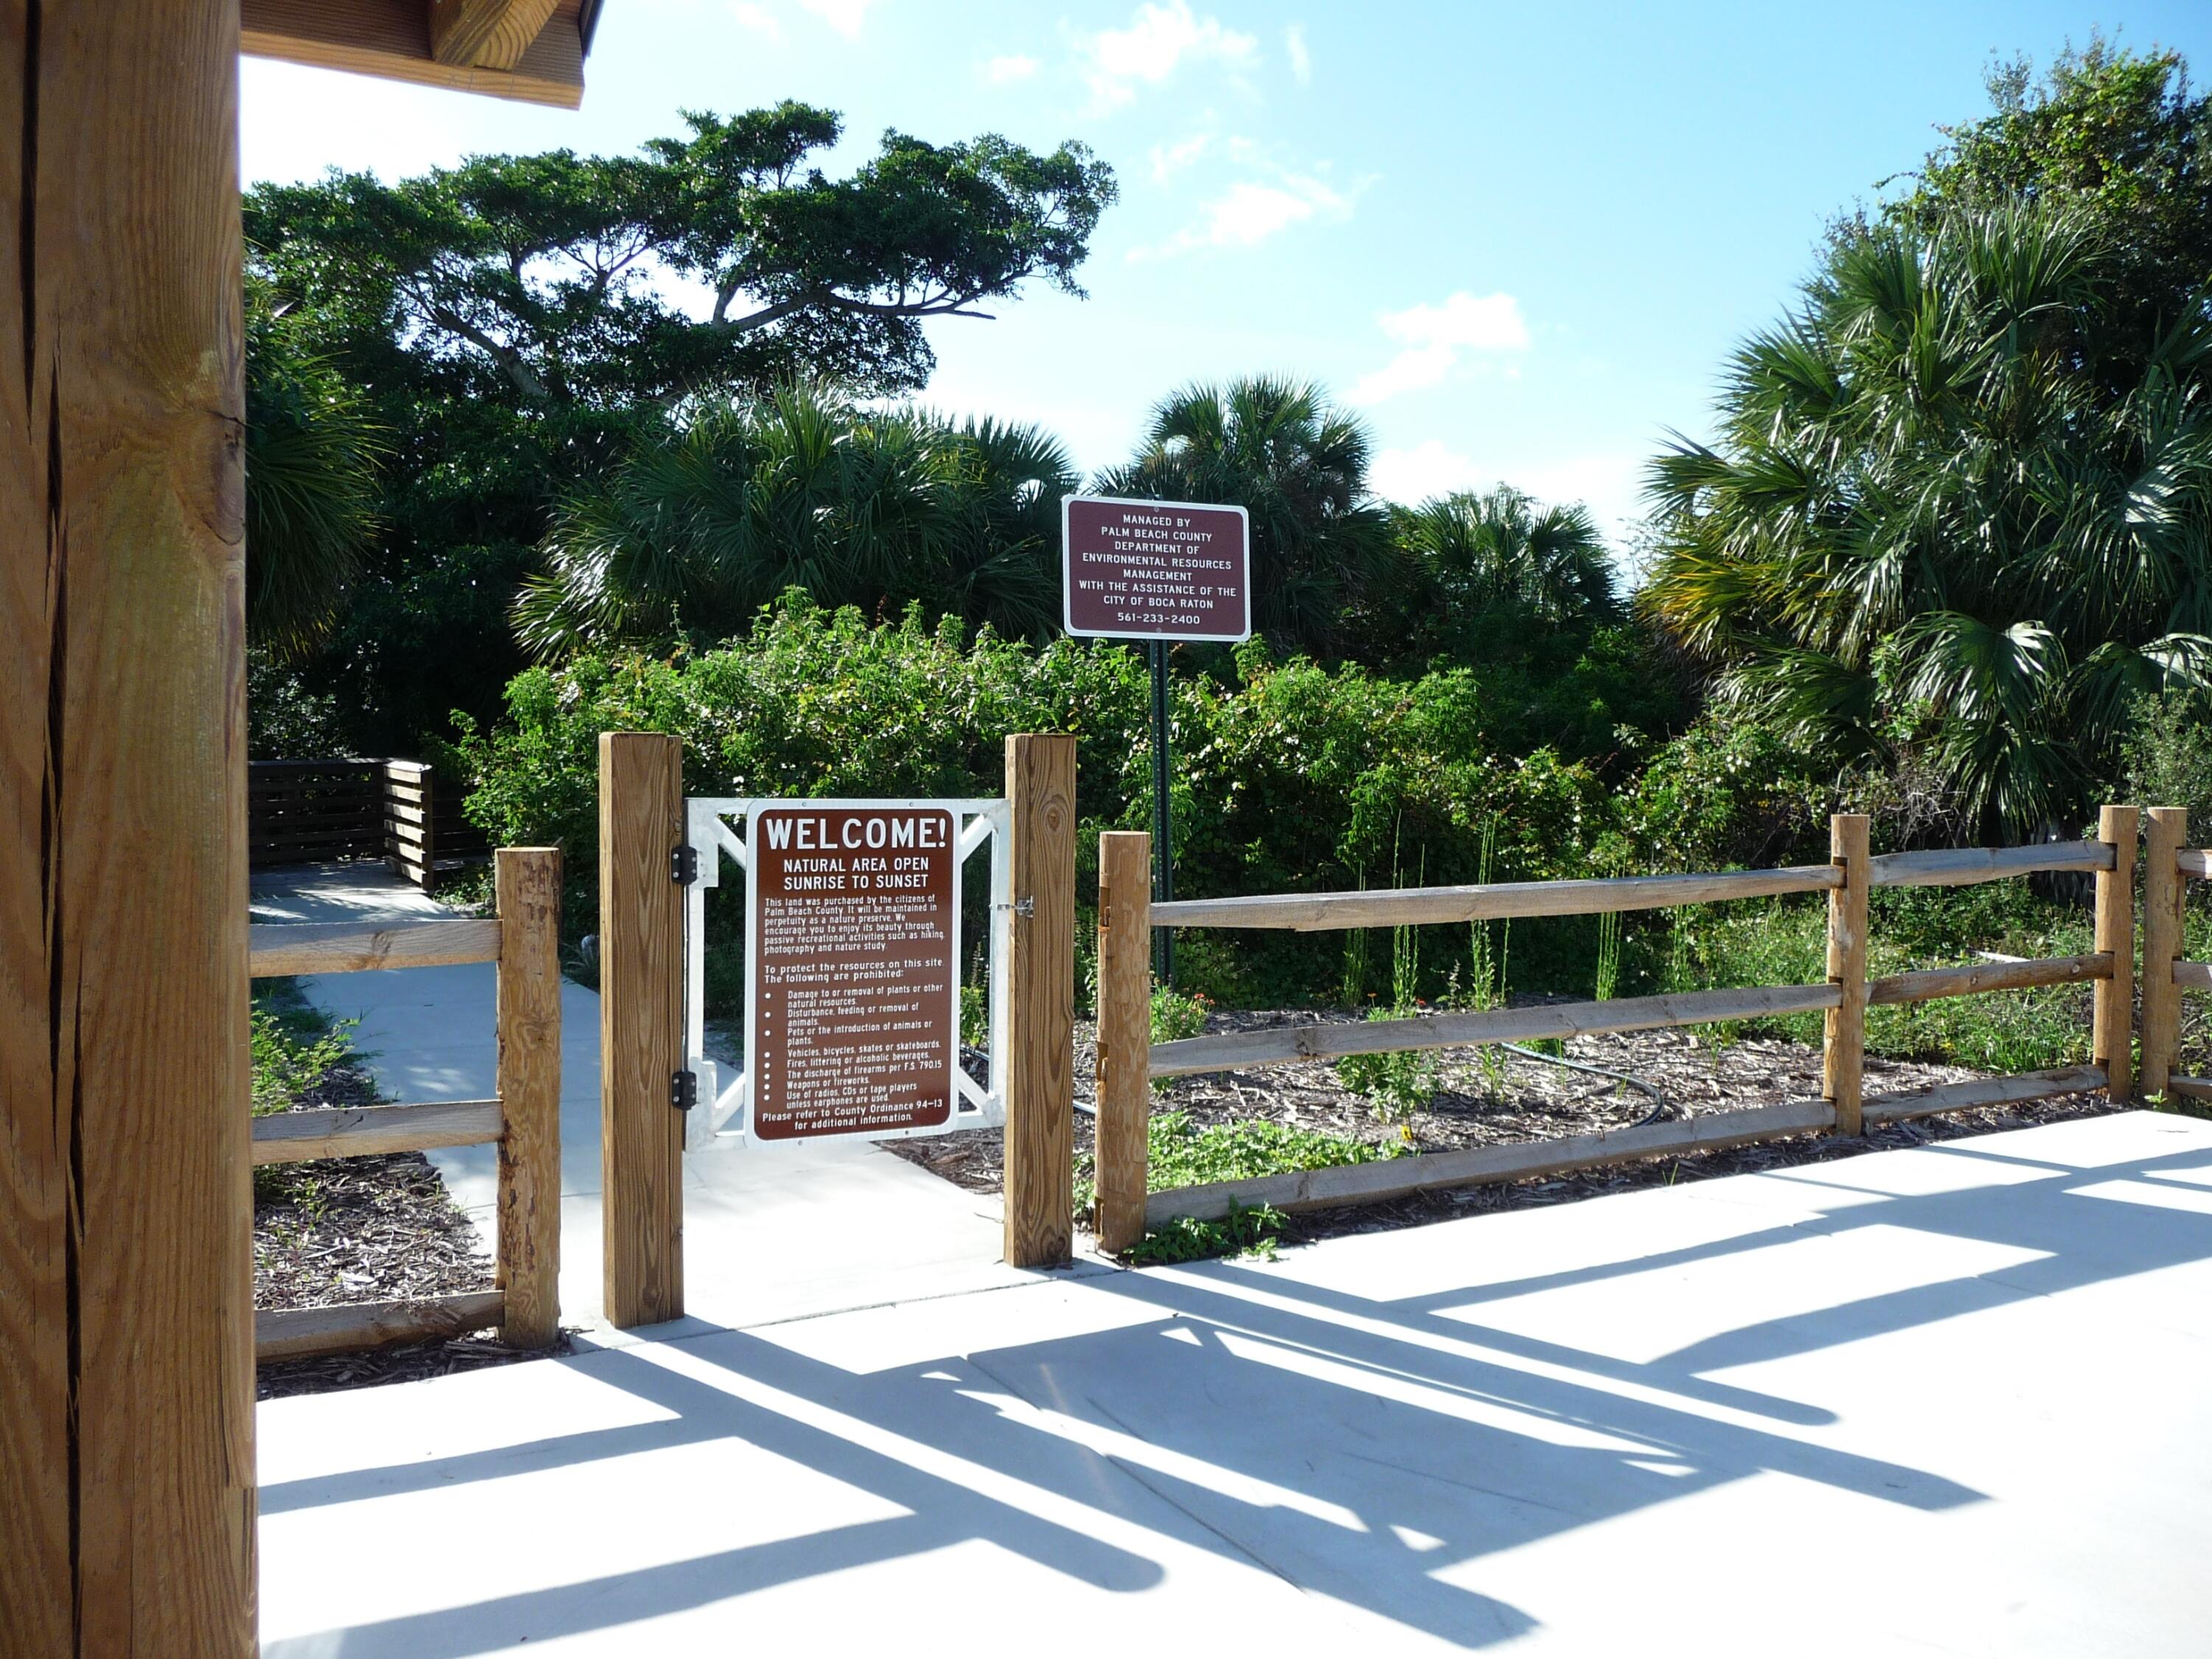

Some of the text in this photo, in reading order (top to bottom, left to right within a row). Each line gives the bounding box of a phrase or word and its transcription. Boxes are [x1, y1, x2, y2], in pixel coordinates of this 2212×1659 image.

[1123, 515, 1191, 527] MANAGED BY
[1101, 527, 1212, 542] PALM BEACH COUNTY
[1115, 541, 1200, 554] DEPARTMENT OF
[1082, 553, 1231, 569] ENVIRONMENTAL RESOURCES
[1123, 569, 1192, 581] MANAGEMENT
[1079, 580, 1237, 597] WITH THE ASSISTANCE OF THE
[1104, 596, 1214, 608] CITY OF BOCA RATON
[1118, 613, 1200, 625] 561-233-2400
[765, 818, 946, 849] WELCOME!
[784, 857, 928, 872] NATURAL AREA OPEN
[785, 874, 928, 890] SUNRISE TO SUNSET
[765, 898, 782, 906] This
[824, 897, 863, 906] purchased
[867, 896, 876, 905] by
[880, 896, 891, 904] the
[895, 895, 925, 903] citizens
[928, 894, 935, 902] of
[788, 907, 812, 915] Beach
[848, 905, 854, 914] It
[874, 905, 882, 913] be
[886, 904, 927, 912] maintained
[765, 917, 806, 927] perpetuity
[830, 915, 855, 923] nature
[765, 928, 806, 936] encourage
[810, 926, 824, 935] you
[839, 925, 860, 934] enjoy
[863, 923, 872, 931] its
[877, 922, 904, 932] beauty
[905, 922, 934, 932] through
[765, 936, 793, 946] passive
[798, 934, 845, 943] recreational
[849, 933, 885, 941] activities
[765, 945, 815, 956] photography
[781, 964, 815, 975] protect
[820, 963, 835, 971] the
[839, 961, 884, 970] resources
[904, 959, 922, 967] this
[765, 975, 782, 984] The
[786, 973, 829, 983] following
[788, 991, 818, 1000] Damage
[844, 987, 873, 996] removal
[877, 986, 883, 995] of
[888, 985, 910, 996] plants
[924, 984, 942, 992] other
[788, 1000, 815, 1008] natural
[838, 1006, 864, 1016] feeding
[880, 1003, 908, 1012] removal
[911, 1002, 919, 1010] of
[787, 1028, 804, 1036] Pets
[818, 1026, 830, 1034] the
[833, 1023, 880, 1032] introduction
[883, 1022, 890, 1030] of
[894, 1020, 922, 1030] animals
[788, 1018, 819, 1026] animals.
[787, 1037, 813, 1048] plants.
[859, 1045, 883, 1053] skates
[897, 1040, 941, 1050] skateboards.
[810, 1056, 841, 1066] littering
[856, 1053, 889, 1062] alcoholic
[893, 1051, 930, 1061] beverages.
[787, 1071, 801, 1079] The
[804, 1068, 841, 1078] discharge
[844, 1067, 851, 1075] of
[855, 1065, 886, 1074] firearms
[889, 1064, 901, 1074] per
[787, 1081, 820, 1091] Weapons
[834, 1076, 870, 1085] fireworks.
[787, 1091, 801, 1100] Use
[804, 1090, 811, 1098] of
[843, 1088, 856, 1096] CDs
[871, 1085, 886, 1095] tape
[890, 1082, 917, 1093] players
[787, 1100, 810, 1109] unless
[814, 1097, 852, 1107] earphones
[762, 1113, 792, 1121] Please
[796, 1110, 817, 1119] refer
[835, 1107, 866, 1116] County
[871, 1103, 913, 1113] Ordinance
[795, 1113, 912, 1130] for additional information.
